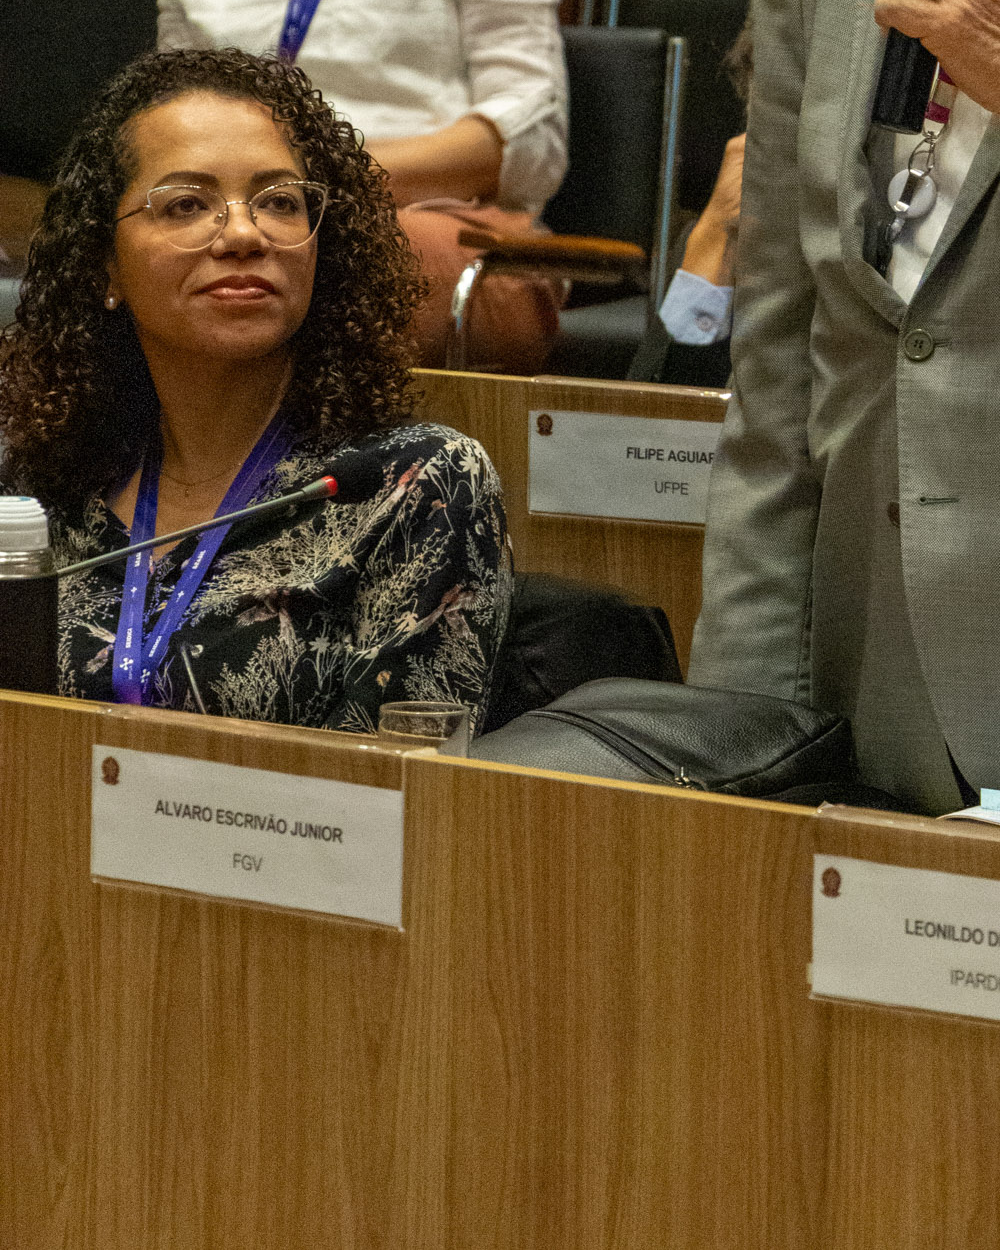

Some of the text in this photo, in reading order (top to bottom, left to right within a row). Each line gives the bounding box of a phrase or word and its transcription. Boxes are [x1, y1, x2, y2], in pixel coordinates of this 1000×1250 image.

[626, 446, 664, 461] FILIPE
[654, 480, 689, 495] UFPE
[155, 799, 344, 843] ALVARO ESCRIVÃO JUNIOR
[233, 853, 263, 872] FGV
[904, 918, 985, 945] LEONILDO
